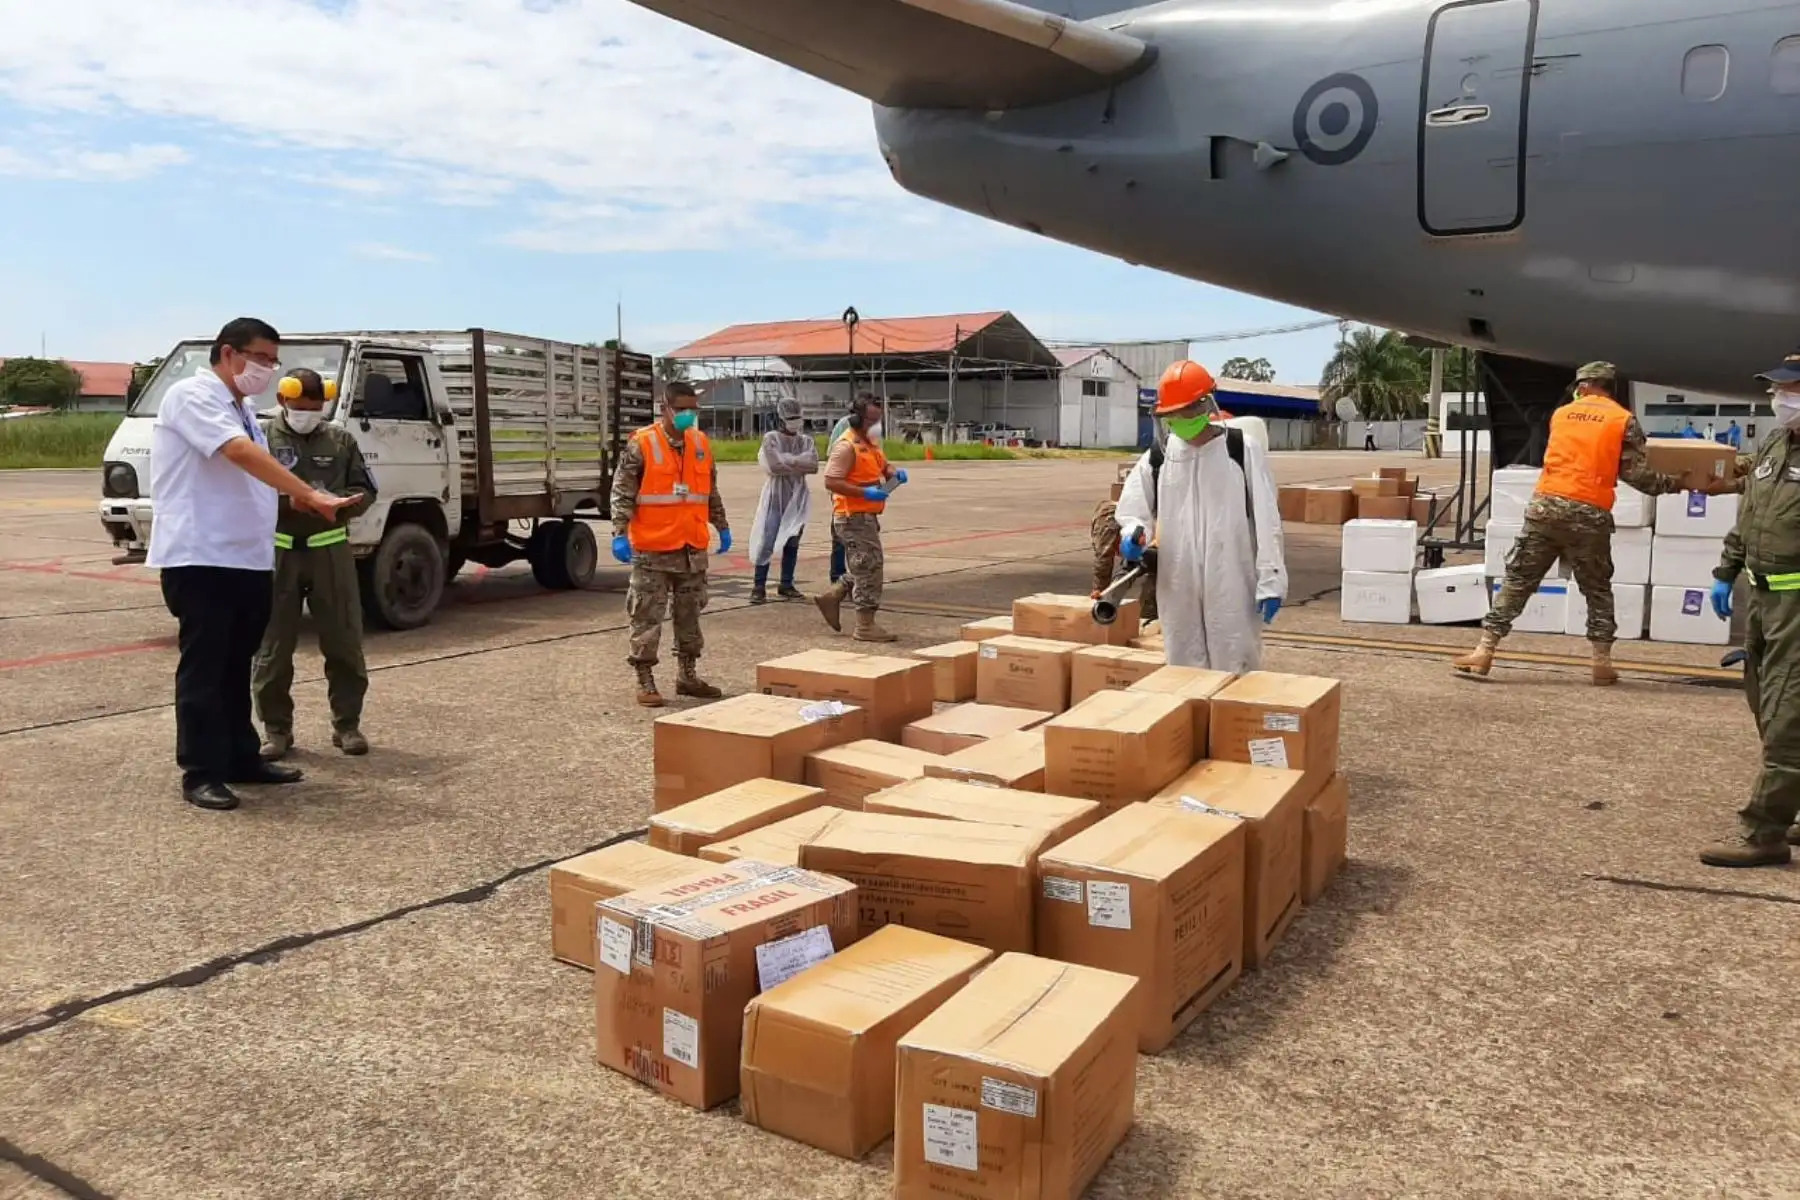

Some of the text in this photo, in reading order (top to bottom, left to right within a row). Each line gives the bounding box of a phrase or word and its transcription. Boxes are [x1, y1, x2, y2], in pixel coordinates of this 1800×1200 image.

[660, 872, 739, 897] FRAGIL
[719, 889, 799, 917] FRAGIL
[623, 1046, 675, 1087] FRAGIL
